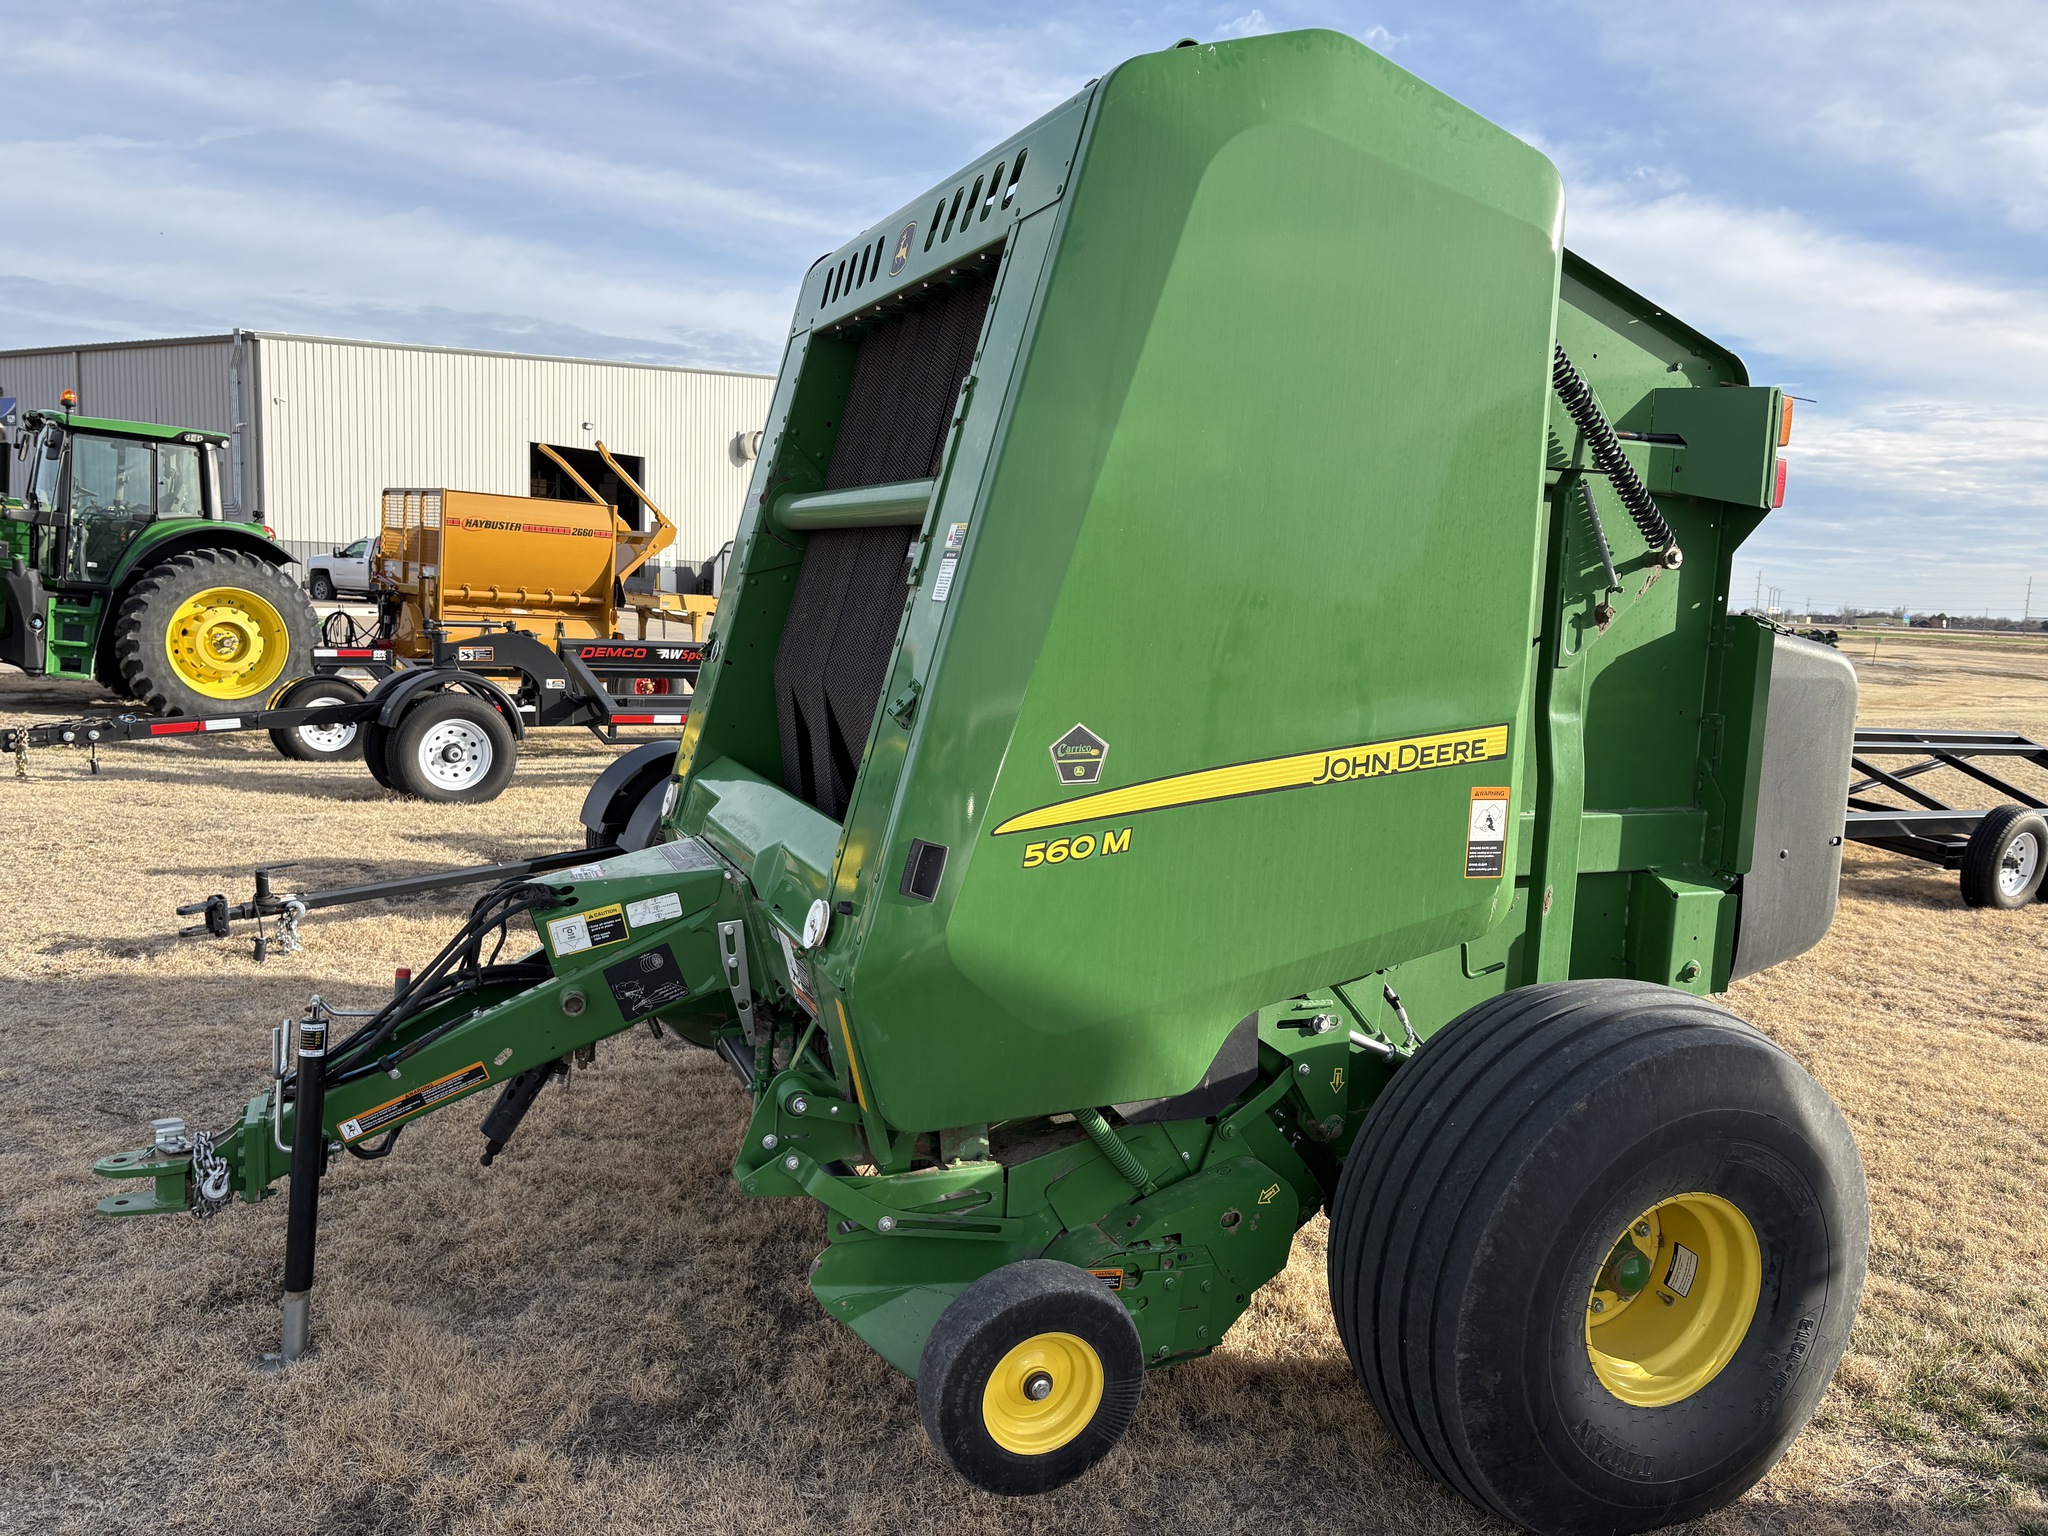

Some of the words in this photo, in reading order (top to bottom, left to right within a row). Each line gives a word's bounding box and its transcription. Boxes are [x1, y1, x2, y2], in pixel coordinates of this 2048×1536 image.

[464, 518, 522, 532] HAYBUSTER
[571, 527, 594, 537] 2660
[580, 647, 647, 659] DEMCO
[1057, 743, 1092, 757] Carrico
[1313, 751, 1391, 782] JOHN
[1398, 738, 1487, 769] DEERE
[1022, 834, 1096, 868] 560
[1100, 827, 1133, 856] M
[593, 908, 618, 918] CAUTION
[407, 1082, 434, 1097] WARNING
[1572, 1419, 1657, 1477] TITAN
